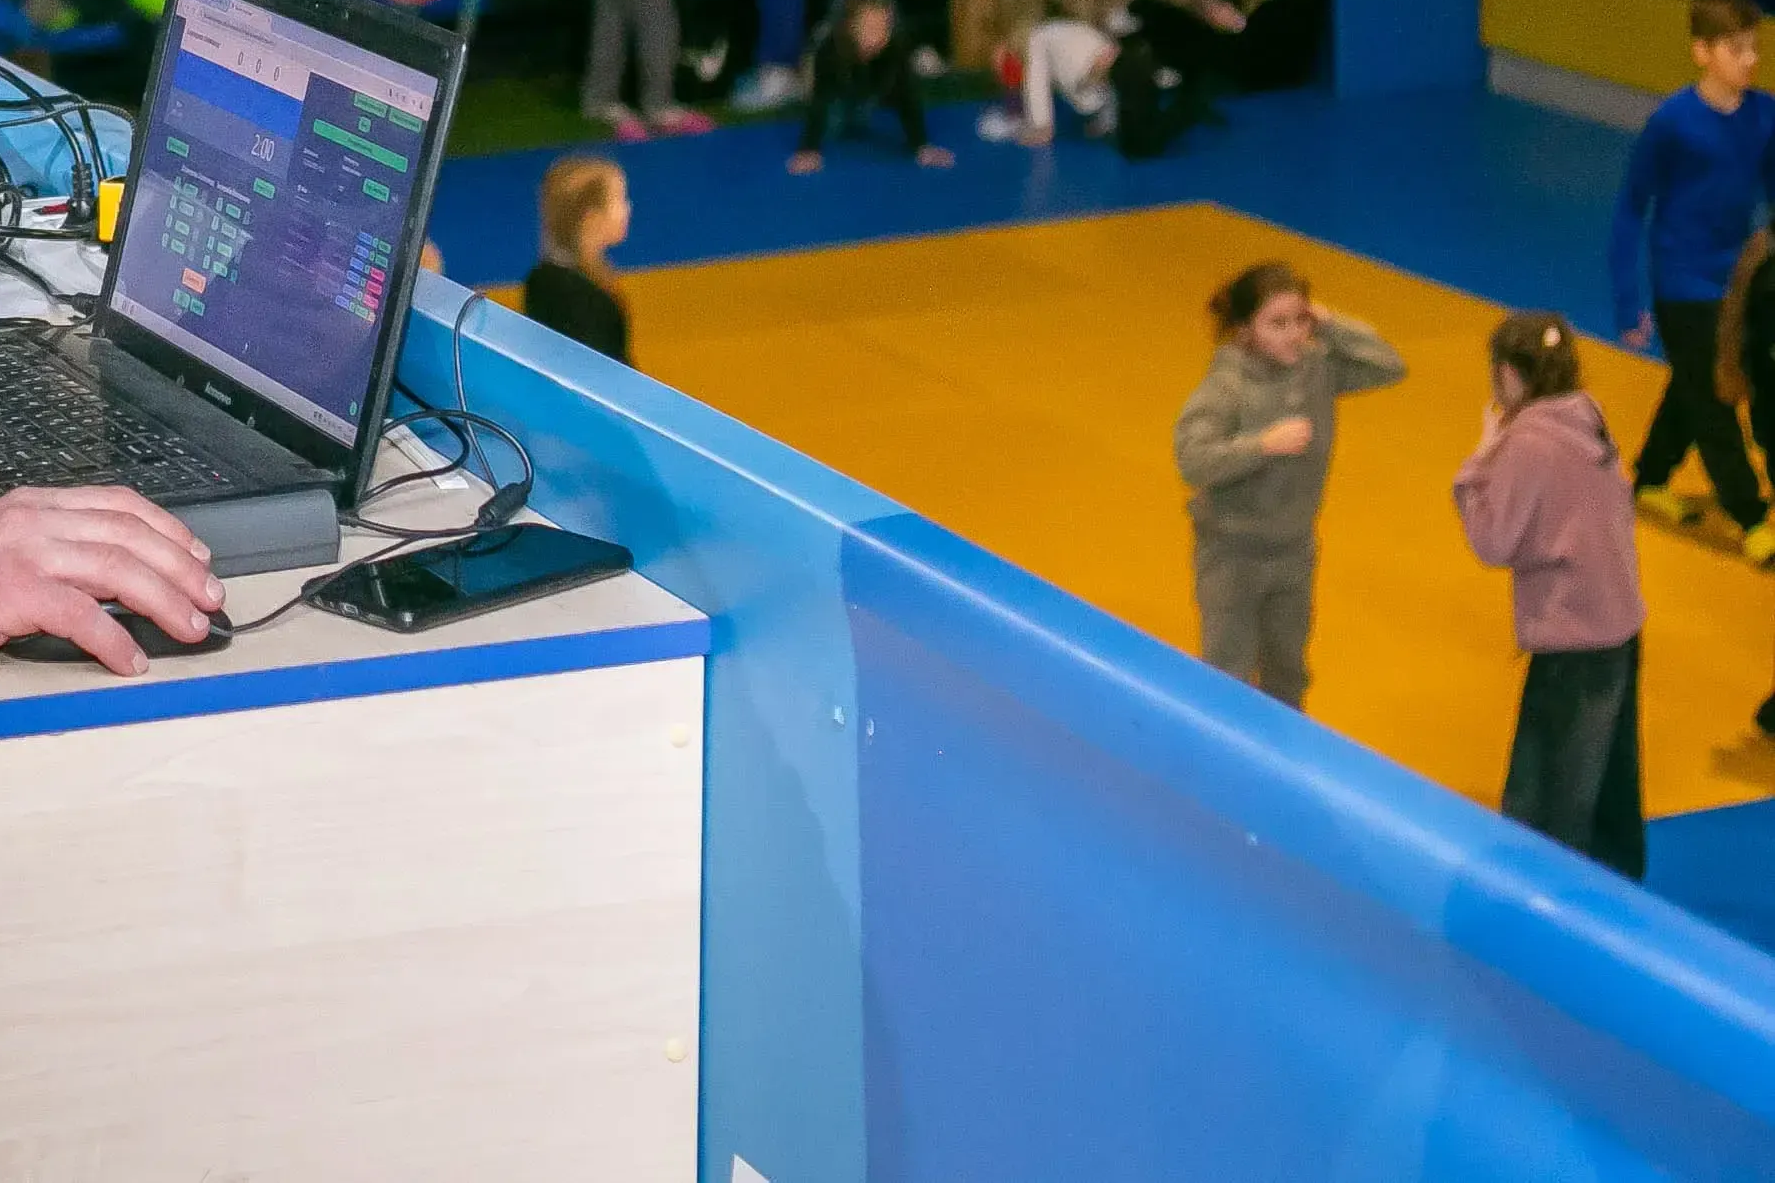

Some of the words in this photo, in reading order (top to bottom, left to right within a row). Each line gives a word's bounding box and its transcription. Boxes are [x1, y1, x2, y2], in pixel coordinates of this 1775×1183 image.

[237, 51, 244, 66] 0
[255, 58, 262, 74] 0
[273, 66, 280, 82] 0
